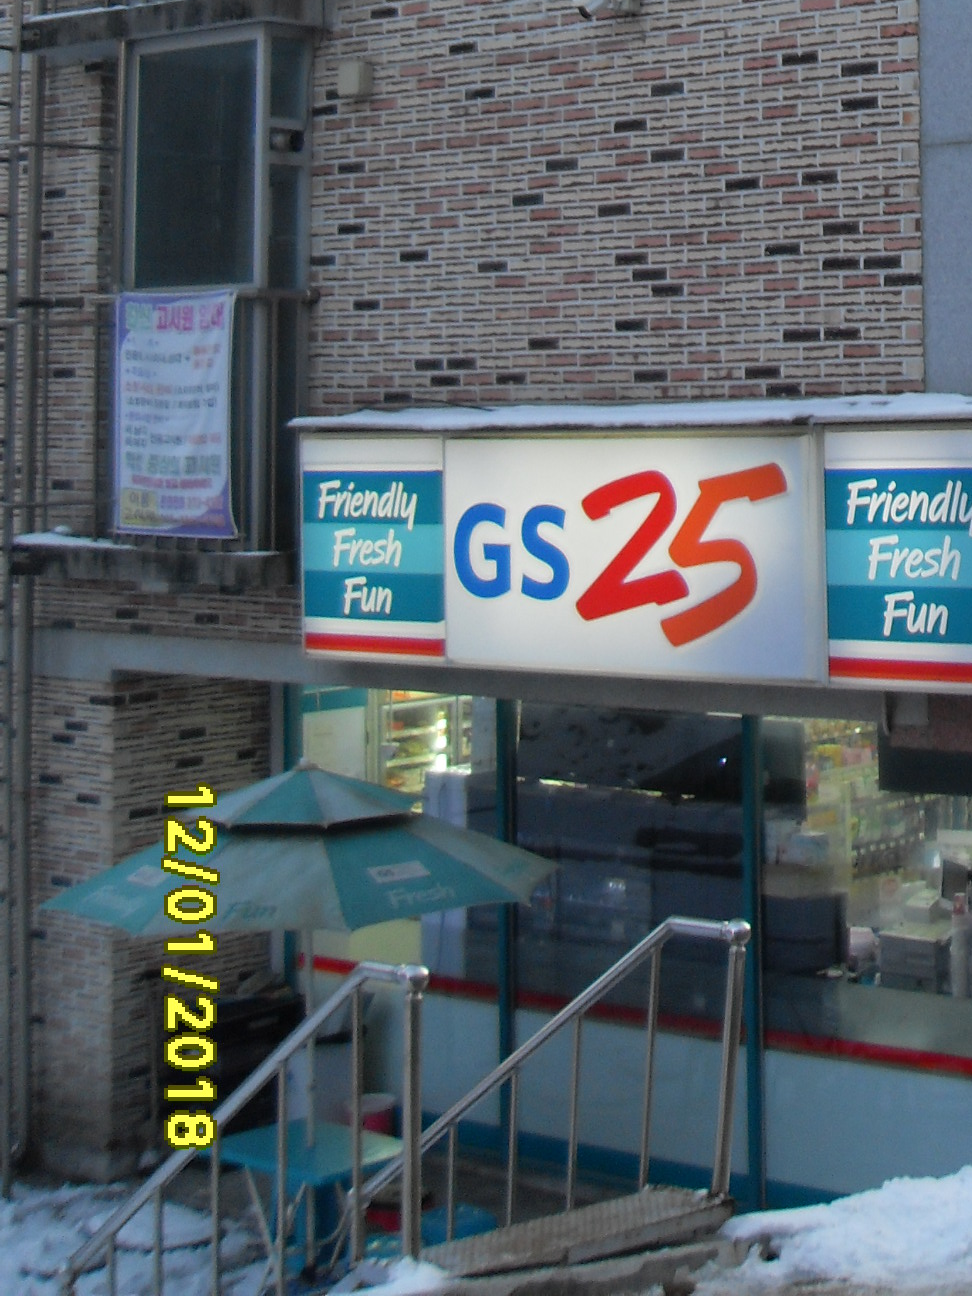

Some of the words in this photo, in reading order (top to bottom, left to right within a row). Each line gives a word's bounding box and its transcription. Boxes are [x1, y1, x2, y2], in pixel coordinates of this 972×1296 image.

[319, 479, 418, 531] Friendly
[333, 527, 402, 567] Fresh
[452, 462, 788, 648] GS25
[868, 534, 961, 581] Fresh
[344, 576, 392, 615] Fun
[883, 590, 949, 637] Fun
